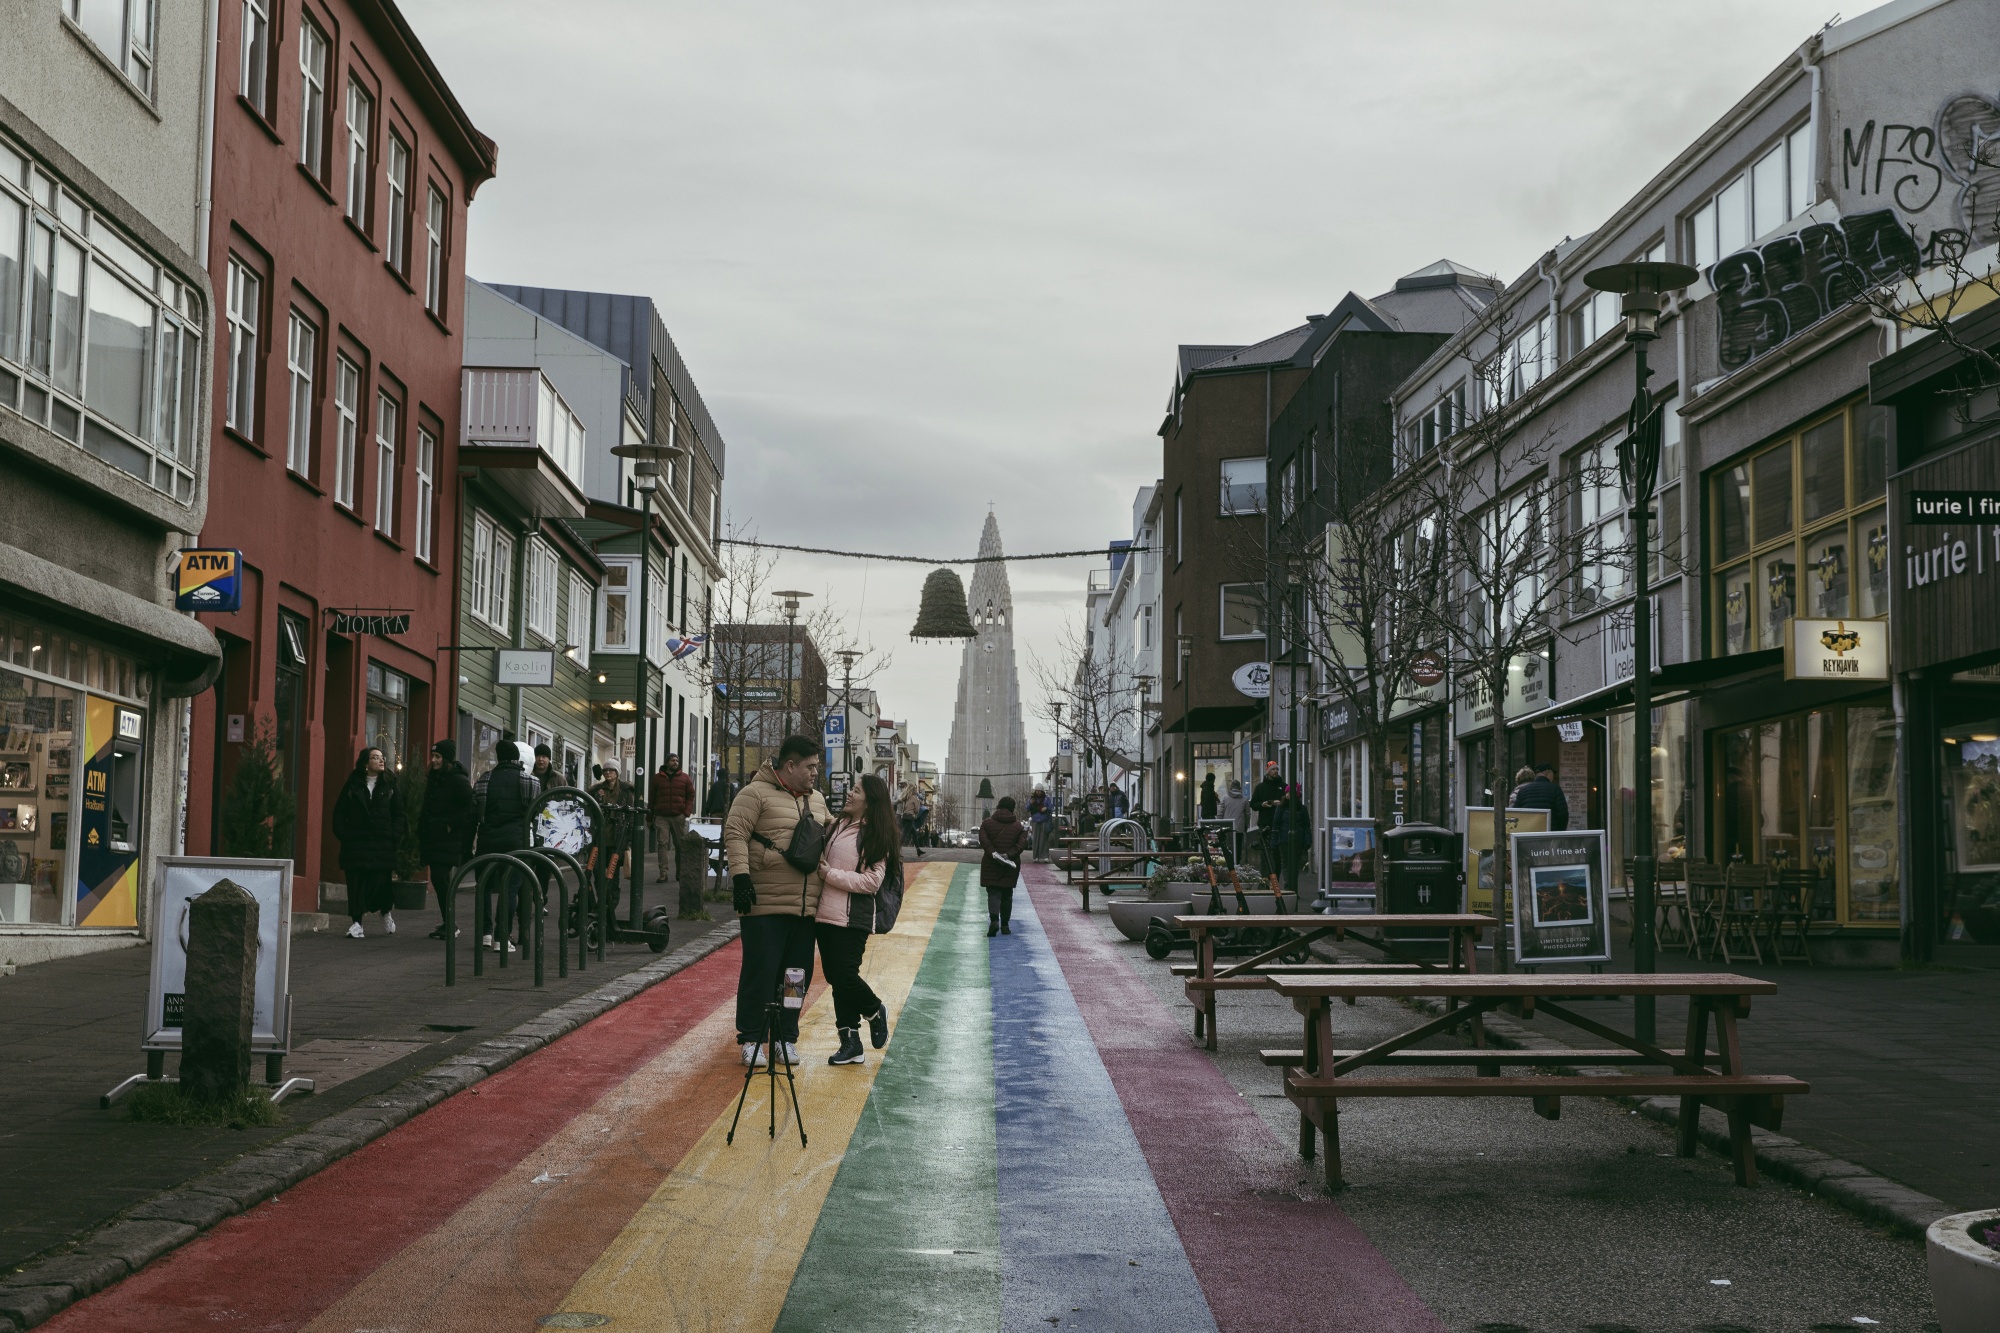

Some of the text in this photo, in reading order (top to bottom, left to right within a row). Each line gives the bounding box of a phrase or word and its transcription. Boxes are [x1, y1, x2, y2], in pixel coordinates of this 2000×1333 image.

[1843, 119, 1942, 214] MFS
[1917, 497, 1962, 514] iurie
[186, 555, 229, 570] ATM
[1906, 532, 1967, 590] iurie
[336, 614, 407, 637] MOKKA
[505, 660, 547, 671] Kaolin
[1615, 654, 1634, 681] Icela
[1823, 657, 1860, 676] REYKJAVÍK
[1330, 706, 1349, 730] Blondie
[120, 714, 138, 737] ATM
[1565, 722, 1579, 730] FREE
[1062, 741, 1069, 750] P
[86, 769, 107, 793] ATM
[1530, 849, 1550, 857] iurie
[1556, 846, 1573, 856] fine
[168, 867, 278, 878] PURE AND TIMELESS
[1471, 901, 1492, 909] SEATING
[1540, 937, 1564, 945] LIMITED
[1543, 942, 1588, 950] PHOTOGRAPHY
[167, 996, 185, 1005] ANN
[166, 1005, 184, 1013] MAR
